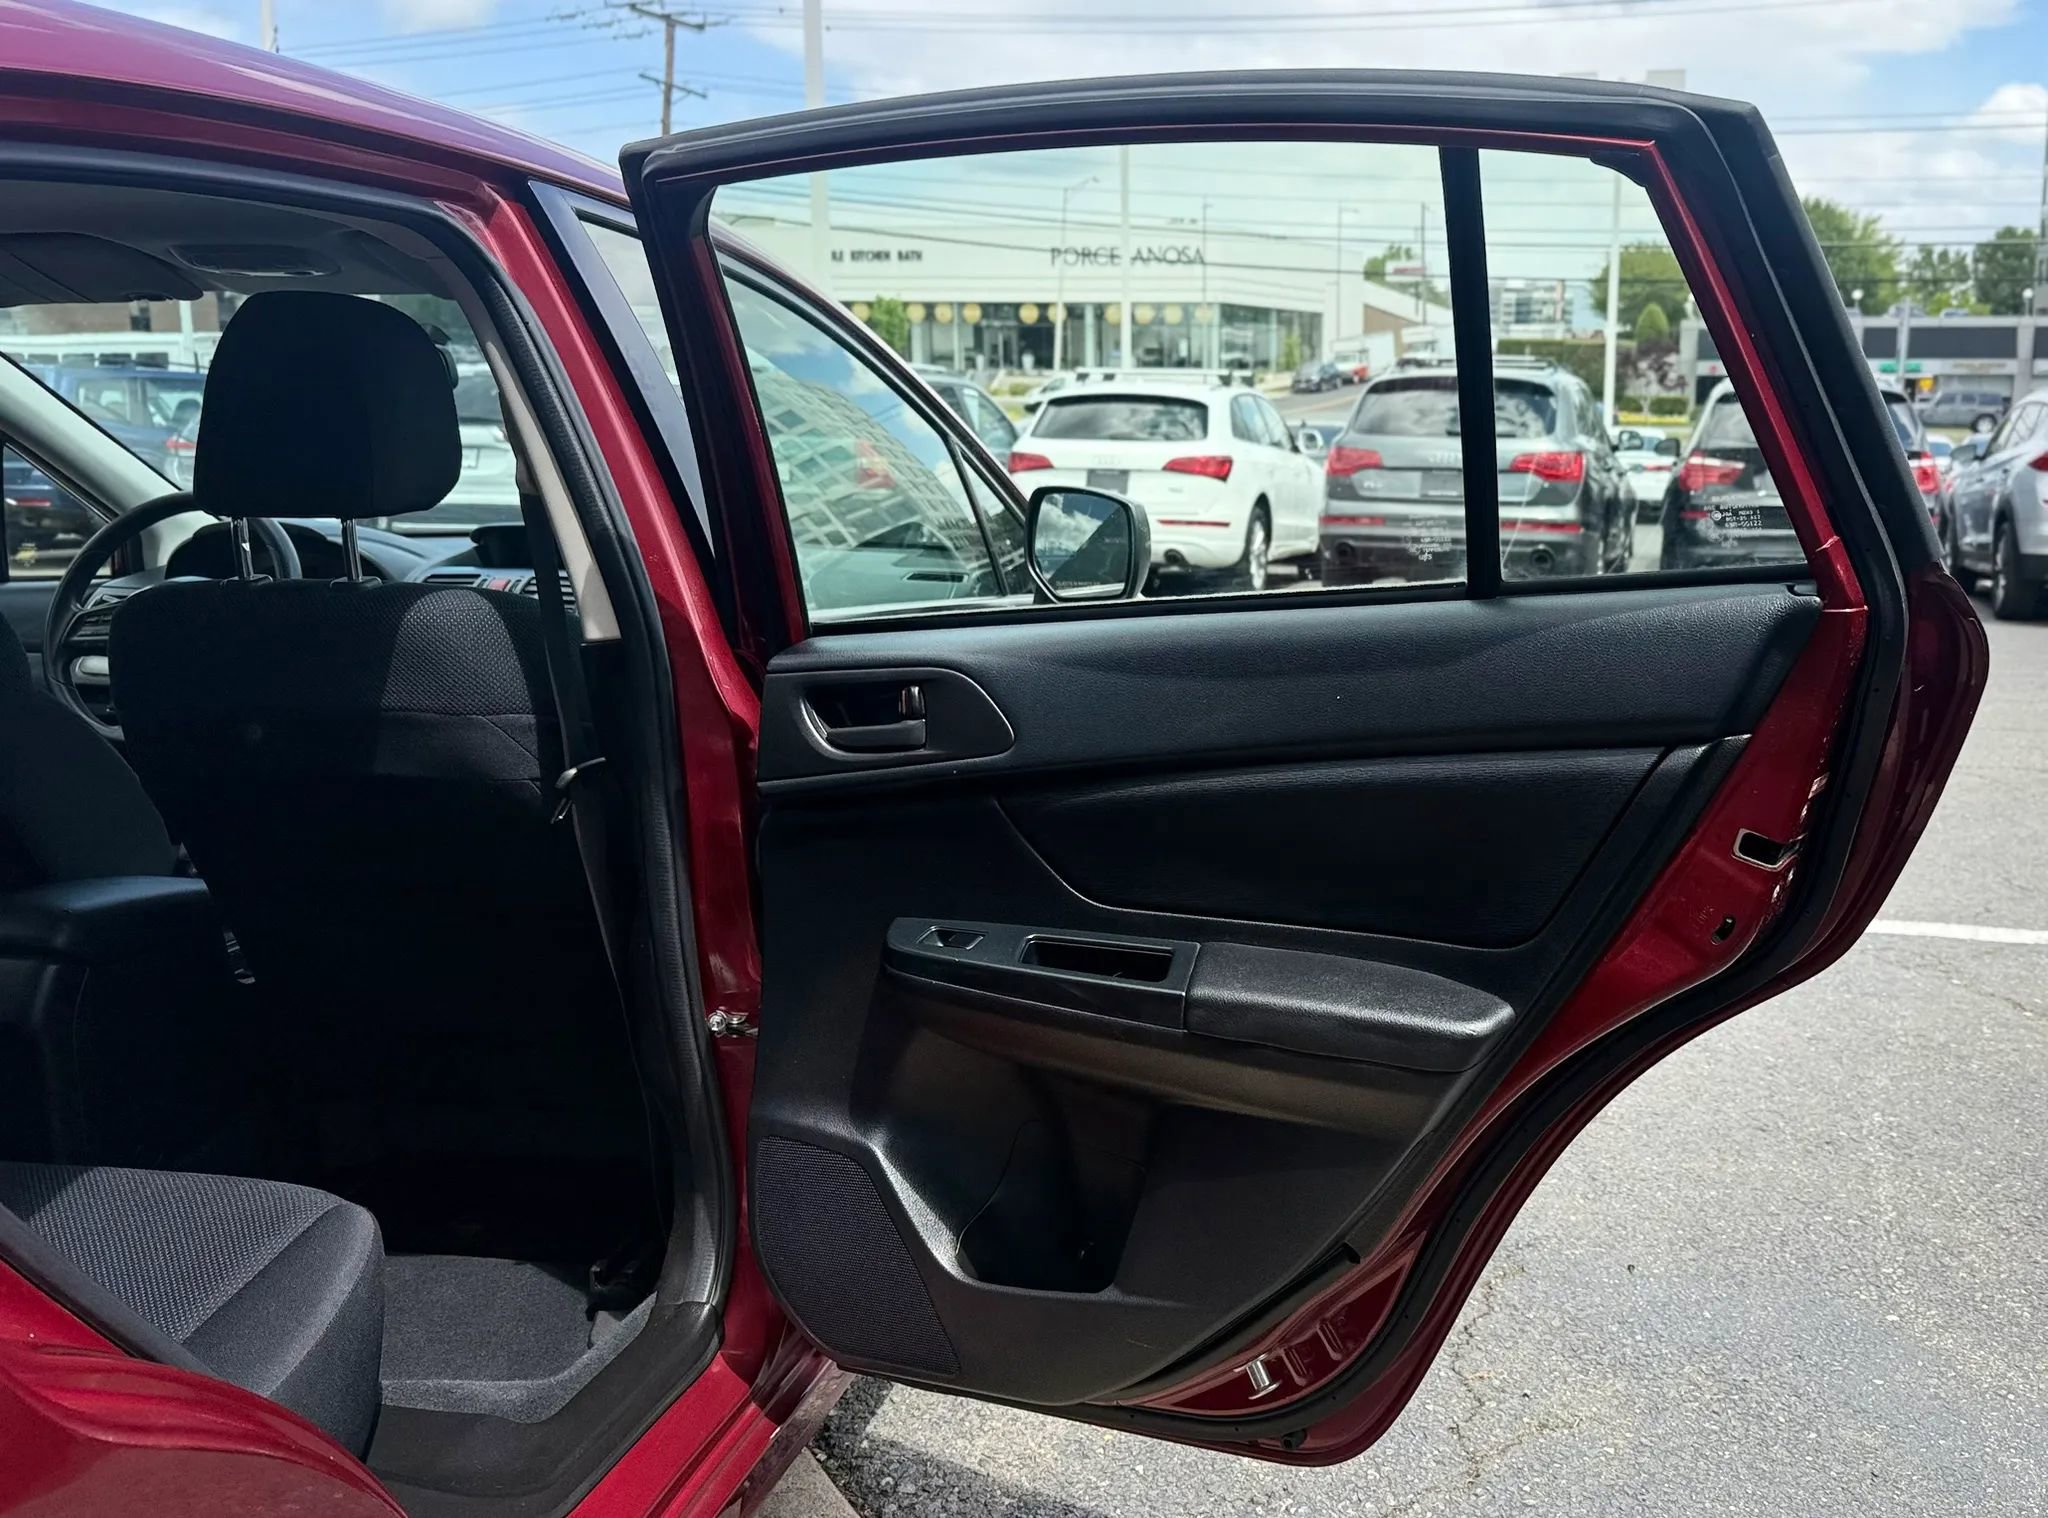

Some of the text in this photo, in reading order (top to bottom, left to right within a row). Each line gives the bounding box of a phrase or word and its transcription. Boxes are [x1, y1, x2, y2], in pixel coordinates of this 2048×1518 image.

[850, 249, 891, 262] KITCHEN
[897, 249, 923, 262] BATH
[1050, 246, 1205, 266] PORCEANOSA
